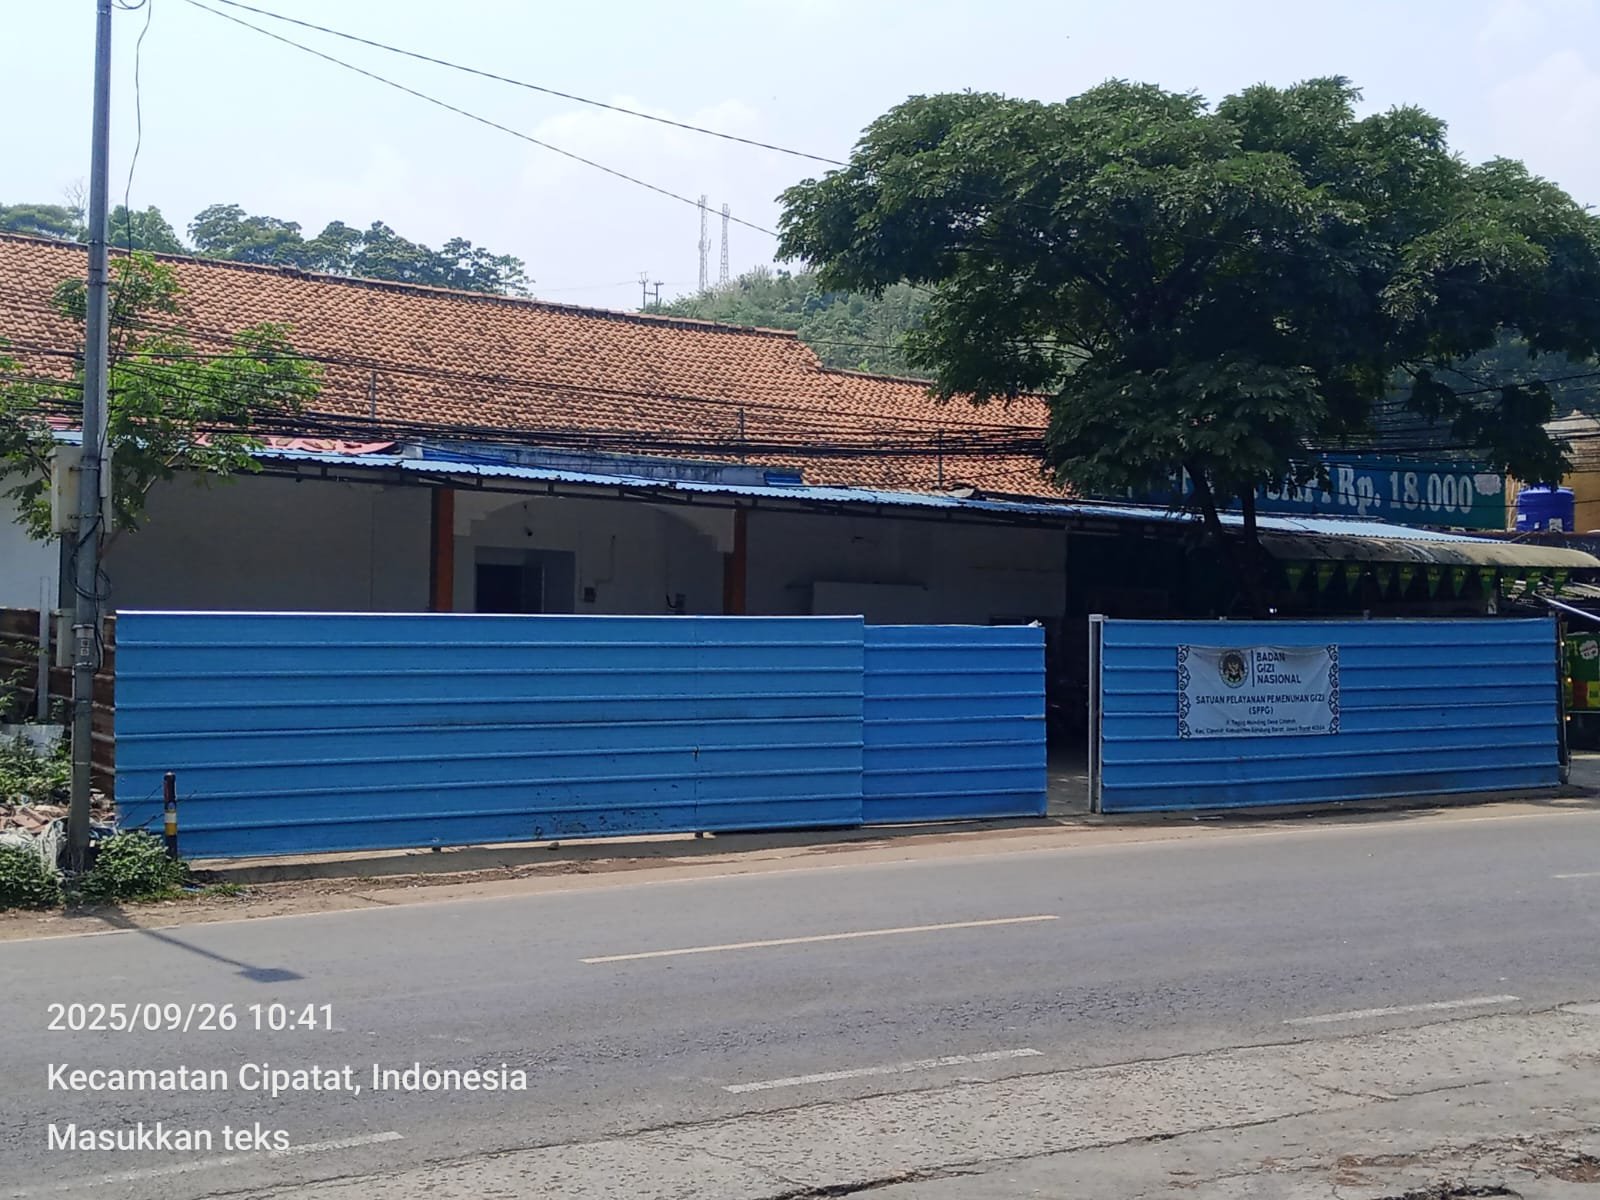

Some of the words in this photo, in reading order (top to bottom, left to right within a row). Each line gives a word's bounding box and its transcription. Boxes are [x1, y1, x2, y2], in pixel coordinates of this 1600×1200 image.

[1337, 463, 1381, 515] Rp.
[1389, 471, 1473, 514] 18.000
[1256, 652, 1286, 662] BADAN
[1256, 663, 1275, 673] GIZI
[1256, 674, 1302, 684] NASIONAL
[1196, 695, 1225, 704] SATUAN
[1226, 695, 1266, 704] PELAYANAN
[1267, 694, 1309, 703] PEMENUHAN
[1310, 694, 1325, 702] GIZI
[1248, 706, 1274, 715] (SPPG)
